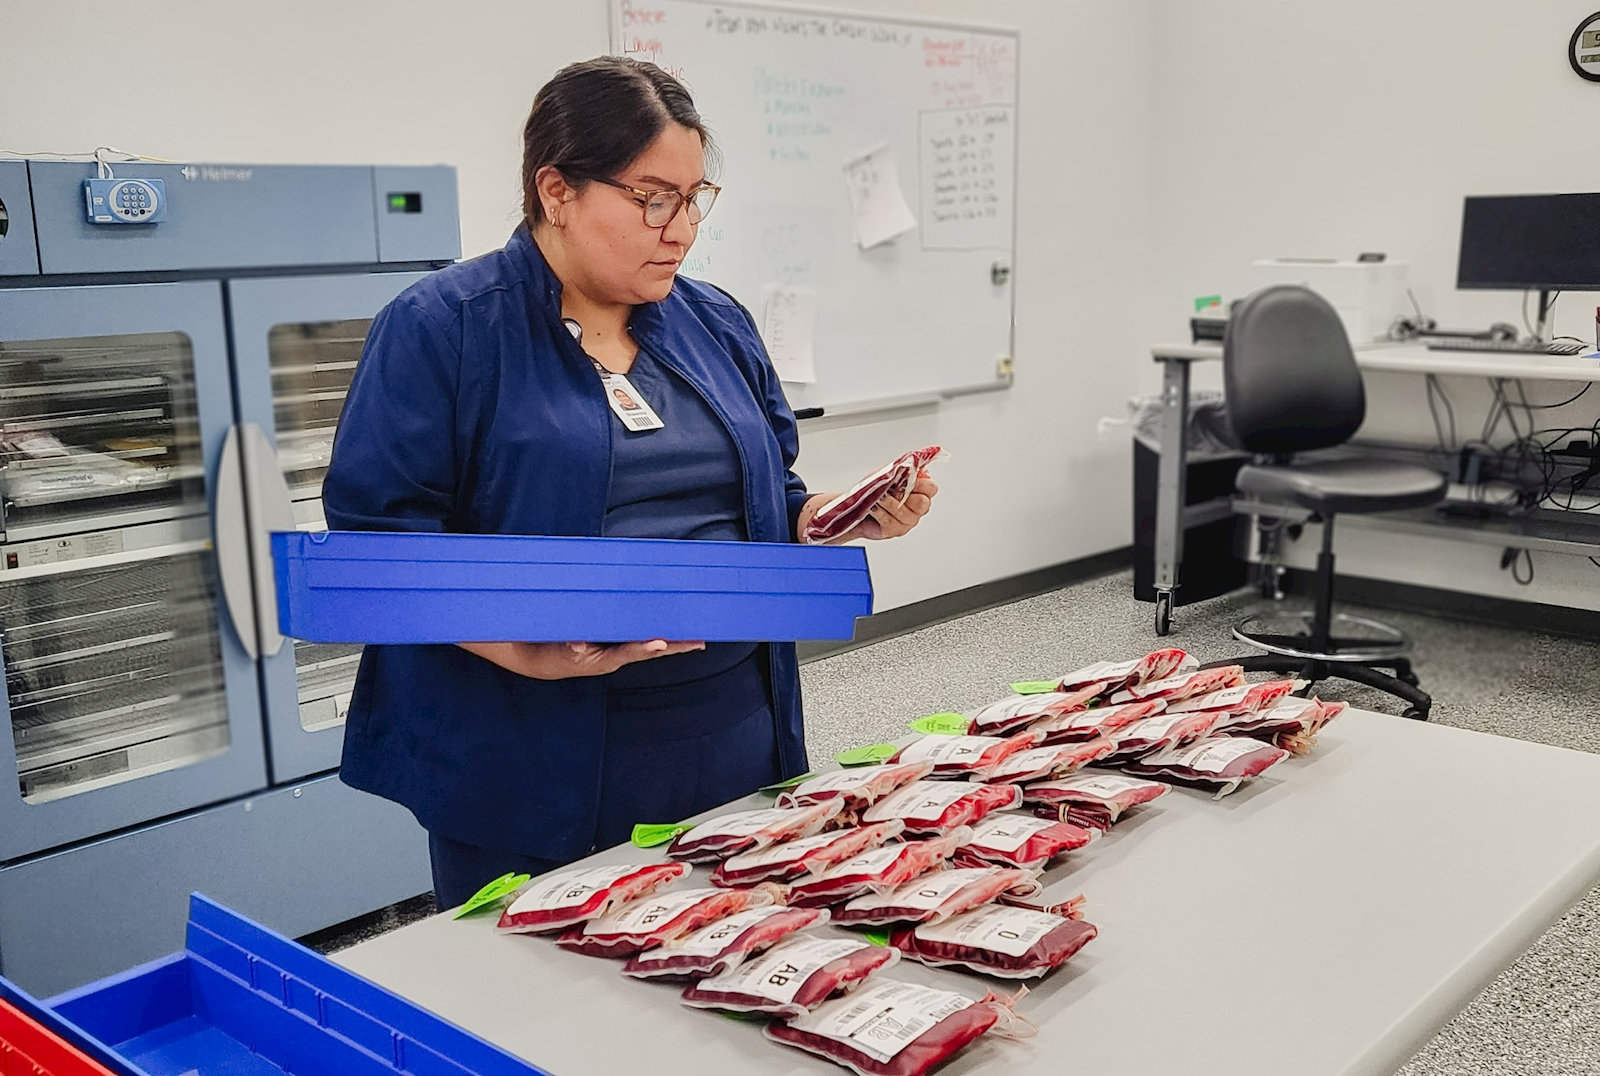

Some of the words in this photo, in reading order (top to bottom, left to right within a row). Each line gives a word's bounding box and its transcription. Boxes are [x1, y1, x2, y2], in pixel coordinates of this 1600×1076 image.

[201, 166, 253, 181] Helmer
[566, 885, 595, 898] AB
[919, 890, 938, 898] O
[642, 906, 668, 924] AB
[710, 924, 739, 939] AB
[998, 930, 1019, 939] O
[768, 964, 799, 986] AB
[868, 1017, 904, 1040] AB
